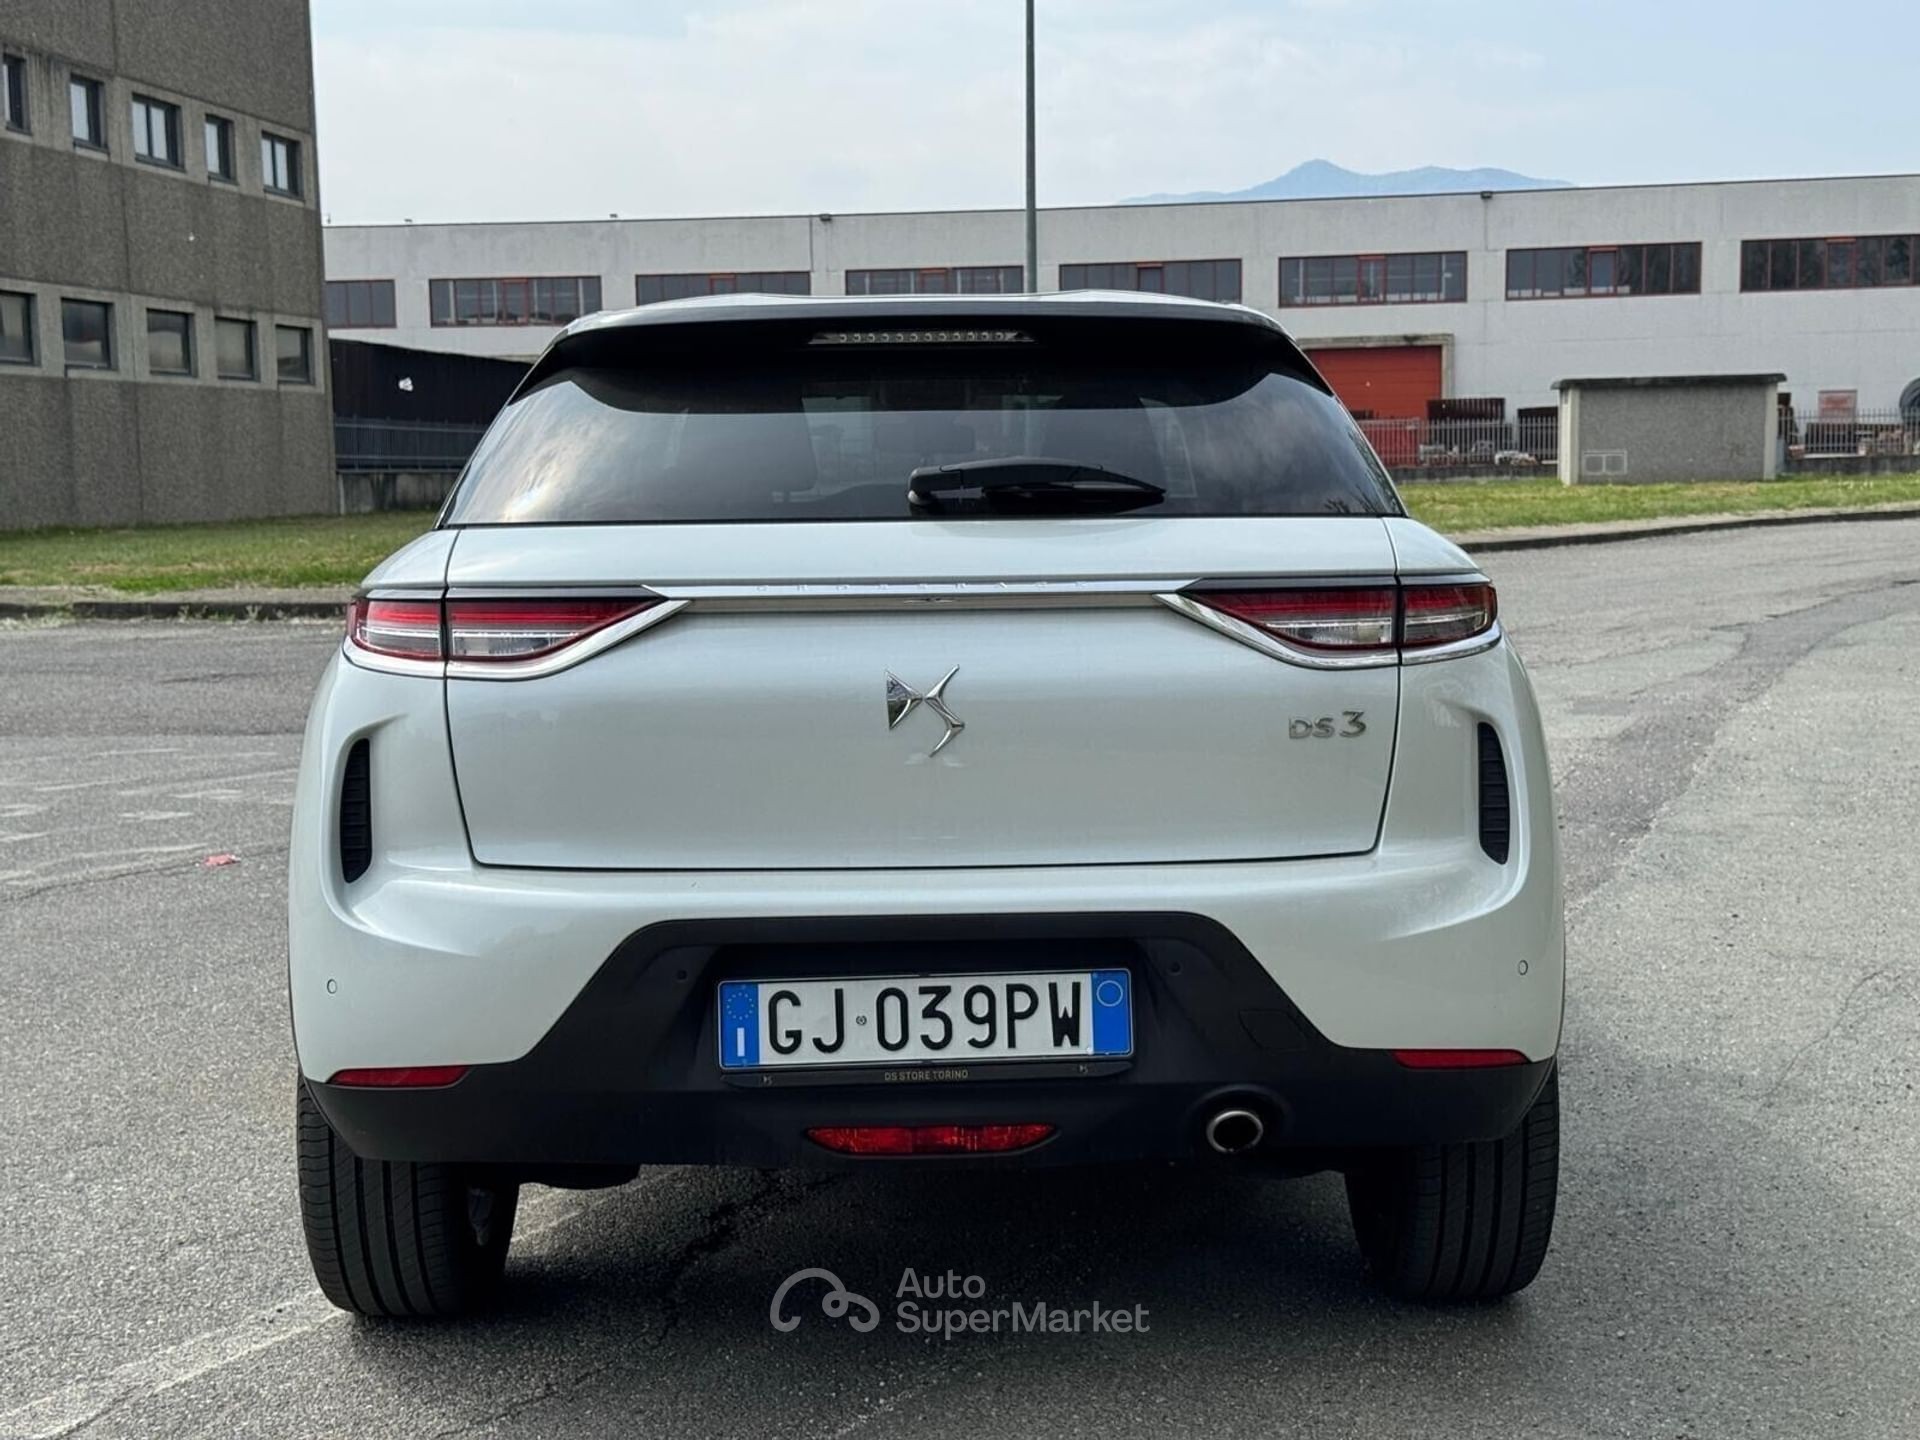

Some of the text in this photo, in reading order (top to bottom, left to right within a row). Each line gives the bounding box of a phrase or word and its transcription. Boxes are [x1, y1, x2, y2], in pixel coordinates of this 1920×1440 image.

[884, 1069, 969, 1081] DS STORE TORINO
